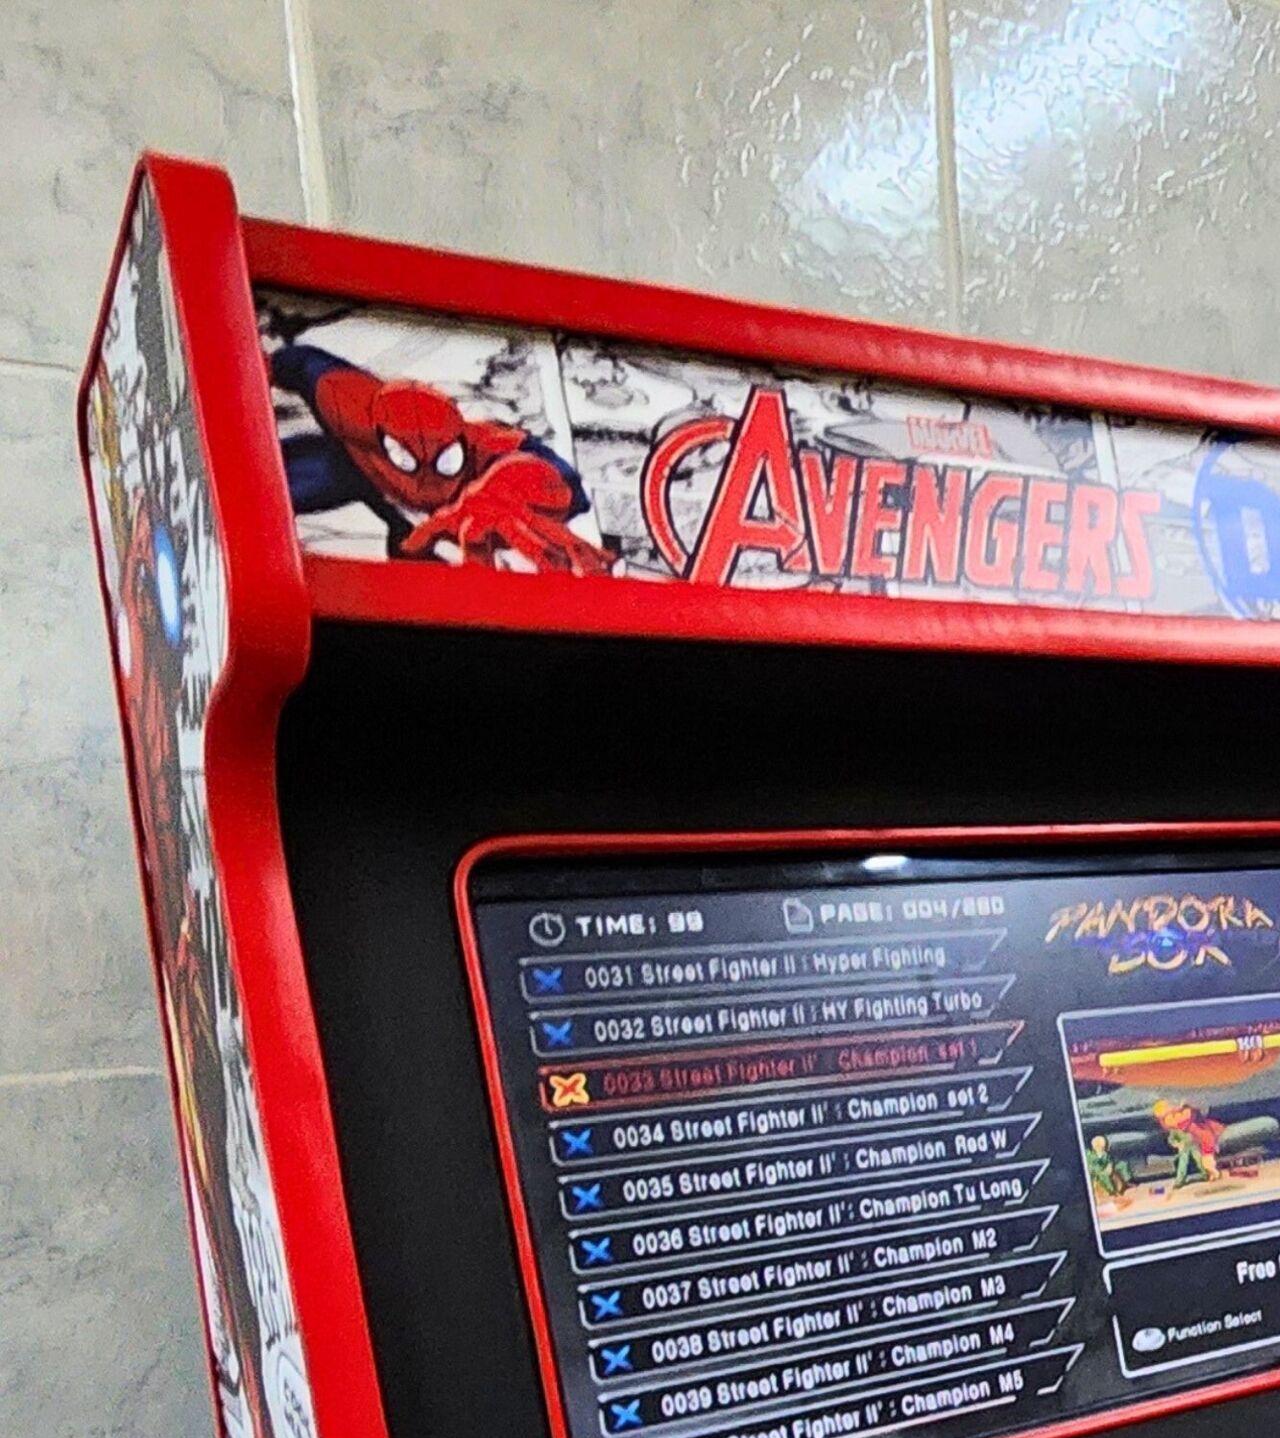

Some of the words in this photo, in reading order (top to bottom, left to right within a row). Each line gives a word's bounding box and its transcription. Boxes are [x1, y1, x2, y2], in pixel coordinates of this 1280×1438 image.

[644, 386, 1163, 599] AVENGERS
[575, 913, 656, 938] TIME:
[1045, 893, 1274, 943] PANDORA
[585, 964, 633, 989] 0031
[642, 957, 704, 985] Street
[709, 954, 778, 982] Fighter
[812, 950, 868, 975] Hyper
[872, 945, 946, 970] Fighting
[594, 1017, 646, 1043] 0032
[651, 1013, 713, 1038] Street
[718, 1007, 787, 1032] Fighter
[854, 995, 929, 1022] Fighting
[932, 990, 983, 1012] Turbo
[659, 1064, 722, 1089] Street
[727, 1058, 796, 1082] Fighter
[838, 1042, 929, 1071] Champion
[613, 1122, 665, 1150] 0034
[670, 1115, 733, 1143] Street
[737, 1106, 806, 1135] Fighter
[848, 1091, 939, 1120] Champion
[947, 1088, 975, 1108] set
[977, 1083, 989, 1104] 2
[623, 1174, 674, 1203] 0035
[679, 1166, 742, 1195] Street
[745, 1157, 814, 1186] Fighter
[855, 1139, 947, 1170] Champion
[954, 1132, 988, 1156] Red
[990, 1127, 1008, 1150] W
[632, 1227, 684, 1257] 0036
[688, 1218, 751, 1248] Street
[755, 1207, 823, 1237] Fighter
[859, 1188, 951, 1220] Champion
[953, 1182, 977, 1205] Tu
[980, 1177, 1022, 1200] Long
[642, 1280, 693, 1310] 0037
[698, 1271, 761, 1300] Street
[763, 1258, 833, 1288] Fighter
[873, 1235, 964, 1268] Champion
[971, 1227, 998, 1250] M2
[1235, 1260, 1277, 1285] Free
[652, 1333, 704, 1364] 0038
[707, 1321, 770, 1352] Street
[773, 1309, 842, 1339] Fighter
[882, 1283, 973, 1318] Champion
[980, 1274, 1006, 1298] M3
[1167, 1318, 1222, 1343] Function
[1224, 1309, 1263, 1330] Select
[661, 1386, 713, 1418] 0039
[716, 1373, 780, 1405] Street
[782, 1358, 851, 1391] Fighter
[891, 1332, 982, 1367] Champion
[988, 1322, 1015, 1347] M4
[901, 1379, 991, 1416] Champion
[998, 1368, 1025, 1394] M5
